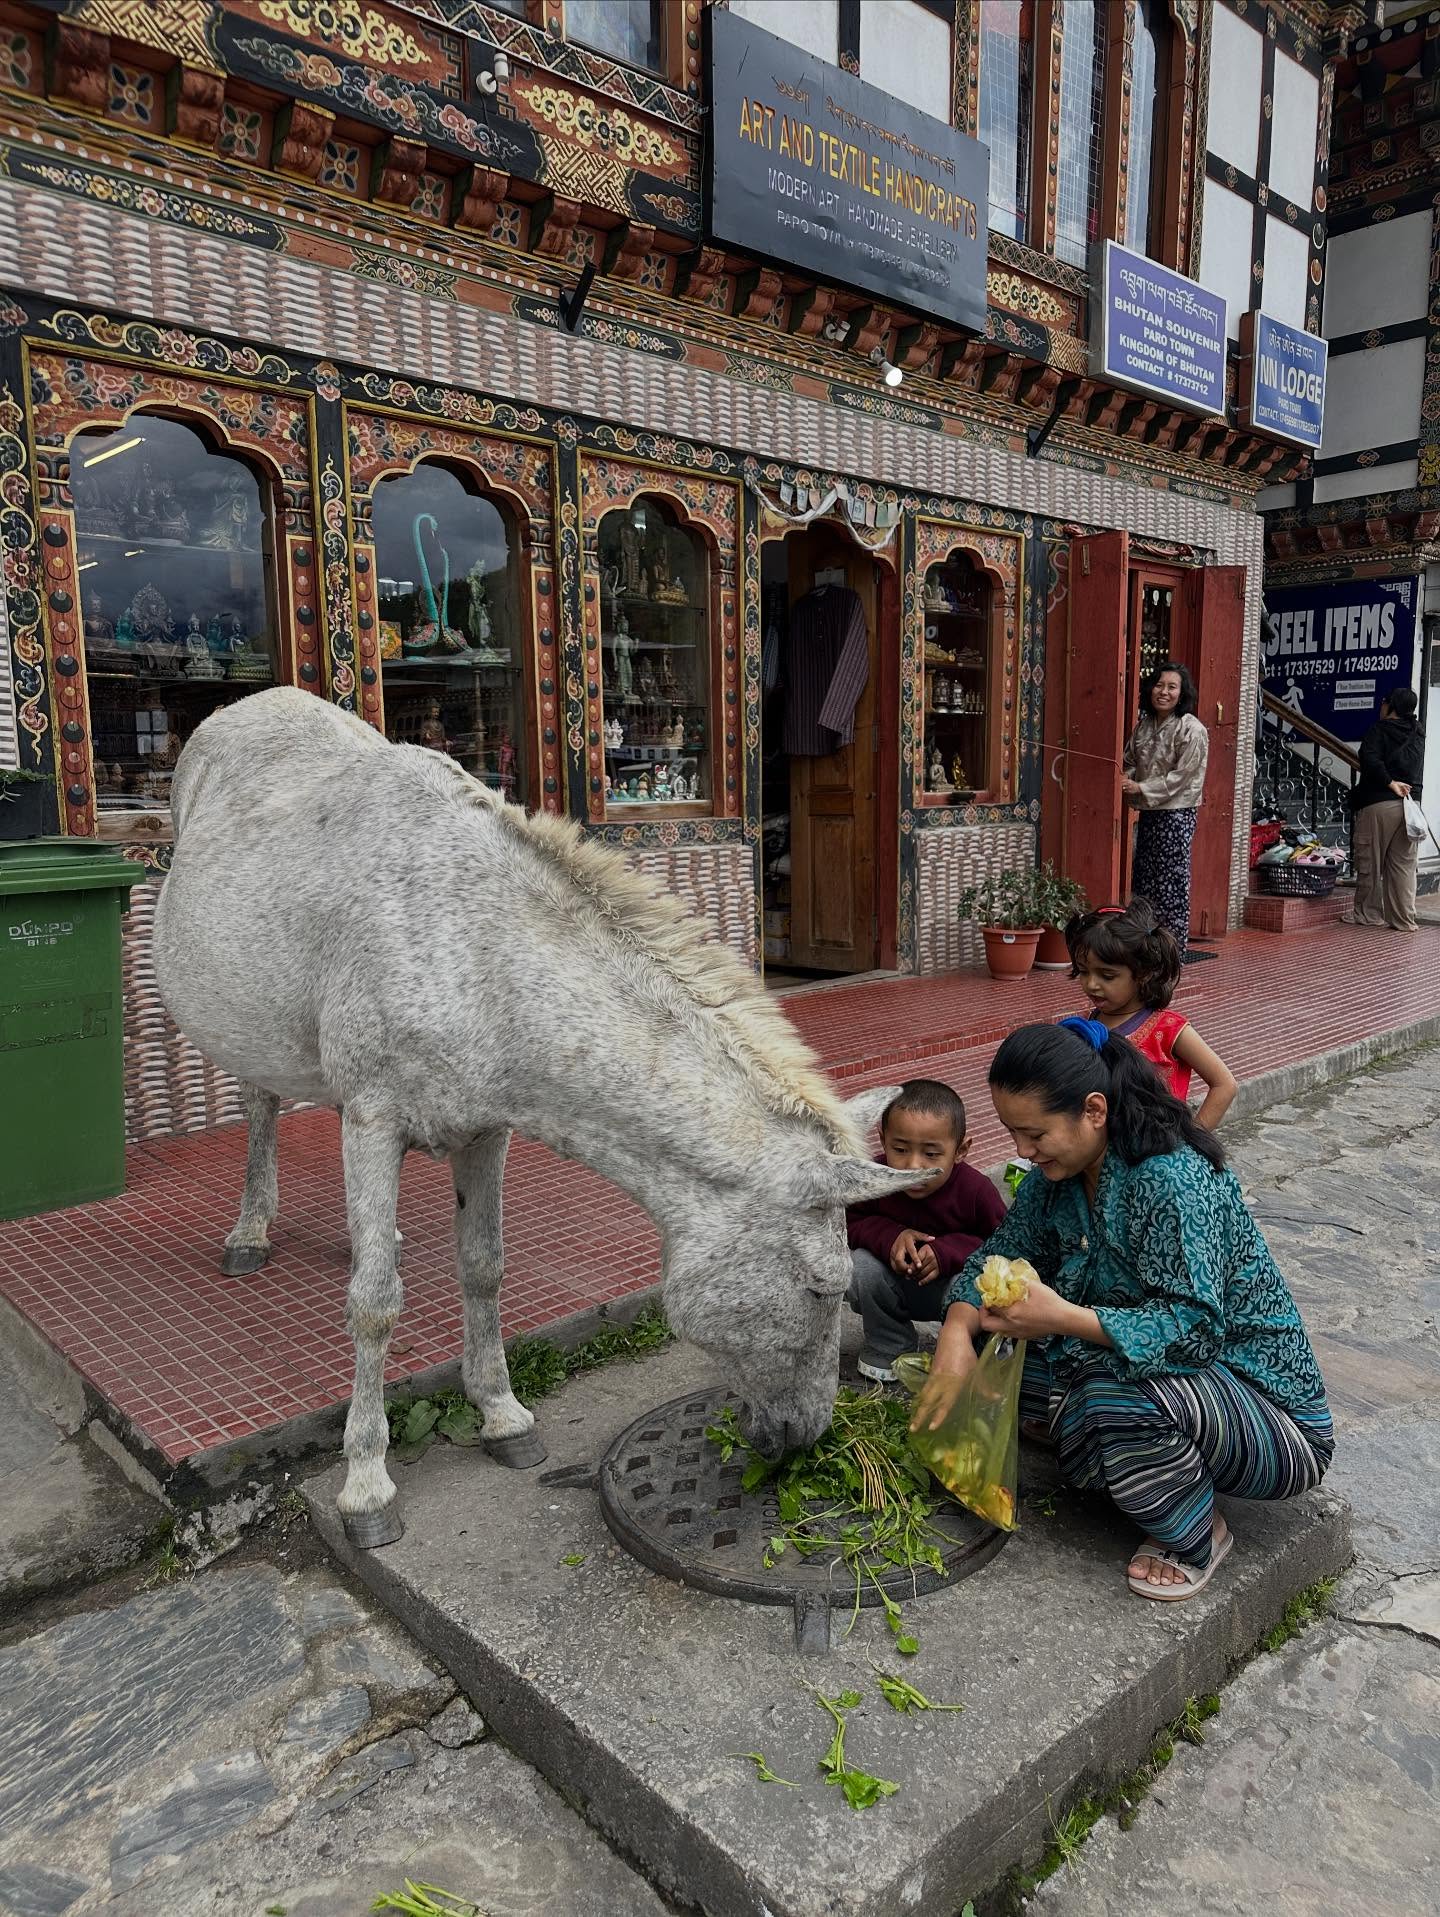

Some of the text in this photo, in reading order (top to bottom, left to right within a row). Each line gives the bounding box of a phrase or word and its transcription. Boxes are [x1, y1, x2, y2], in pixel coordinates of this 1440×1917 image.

[739, 96, 775, 150] ART
[780, 115, 814, 167] AND
[819, 131, 881, 196] TEXTILE
[885, 162, 977, 240] HANDICRAFTS
[768, 168, 816, 207] MODERN
[819, 189, 839, 216] ART
[848, 204, 903, 242] HANDMADE
[1115, 297, 1221, 354] BHUTAN SOUVENIR
[1144, 327, 1195, 359] PARO TOWN
[1120, 334, 1215, 383] KINGDOM OF BHUTAN
[1126, 354, 1164, 376] CONTACT
[1174, 373, 1209, 395] 17373712
[1261, 354, 1322, 404] NN LODGE
[1261, 602, 1395, 656] SEEL ITEMS
[1285, 659, 1335, 676] 17337529
[1344, 655, 1398, 673] 17492309
